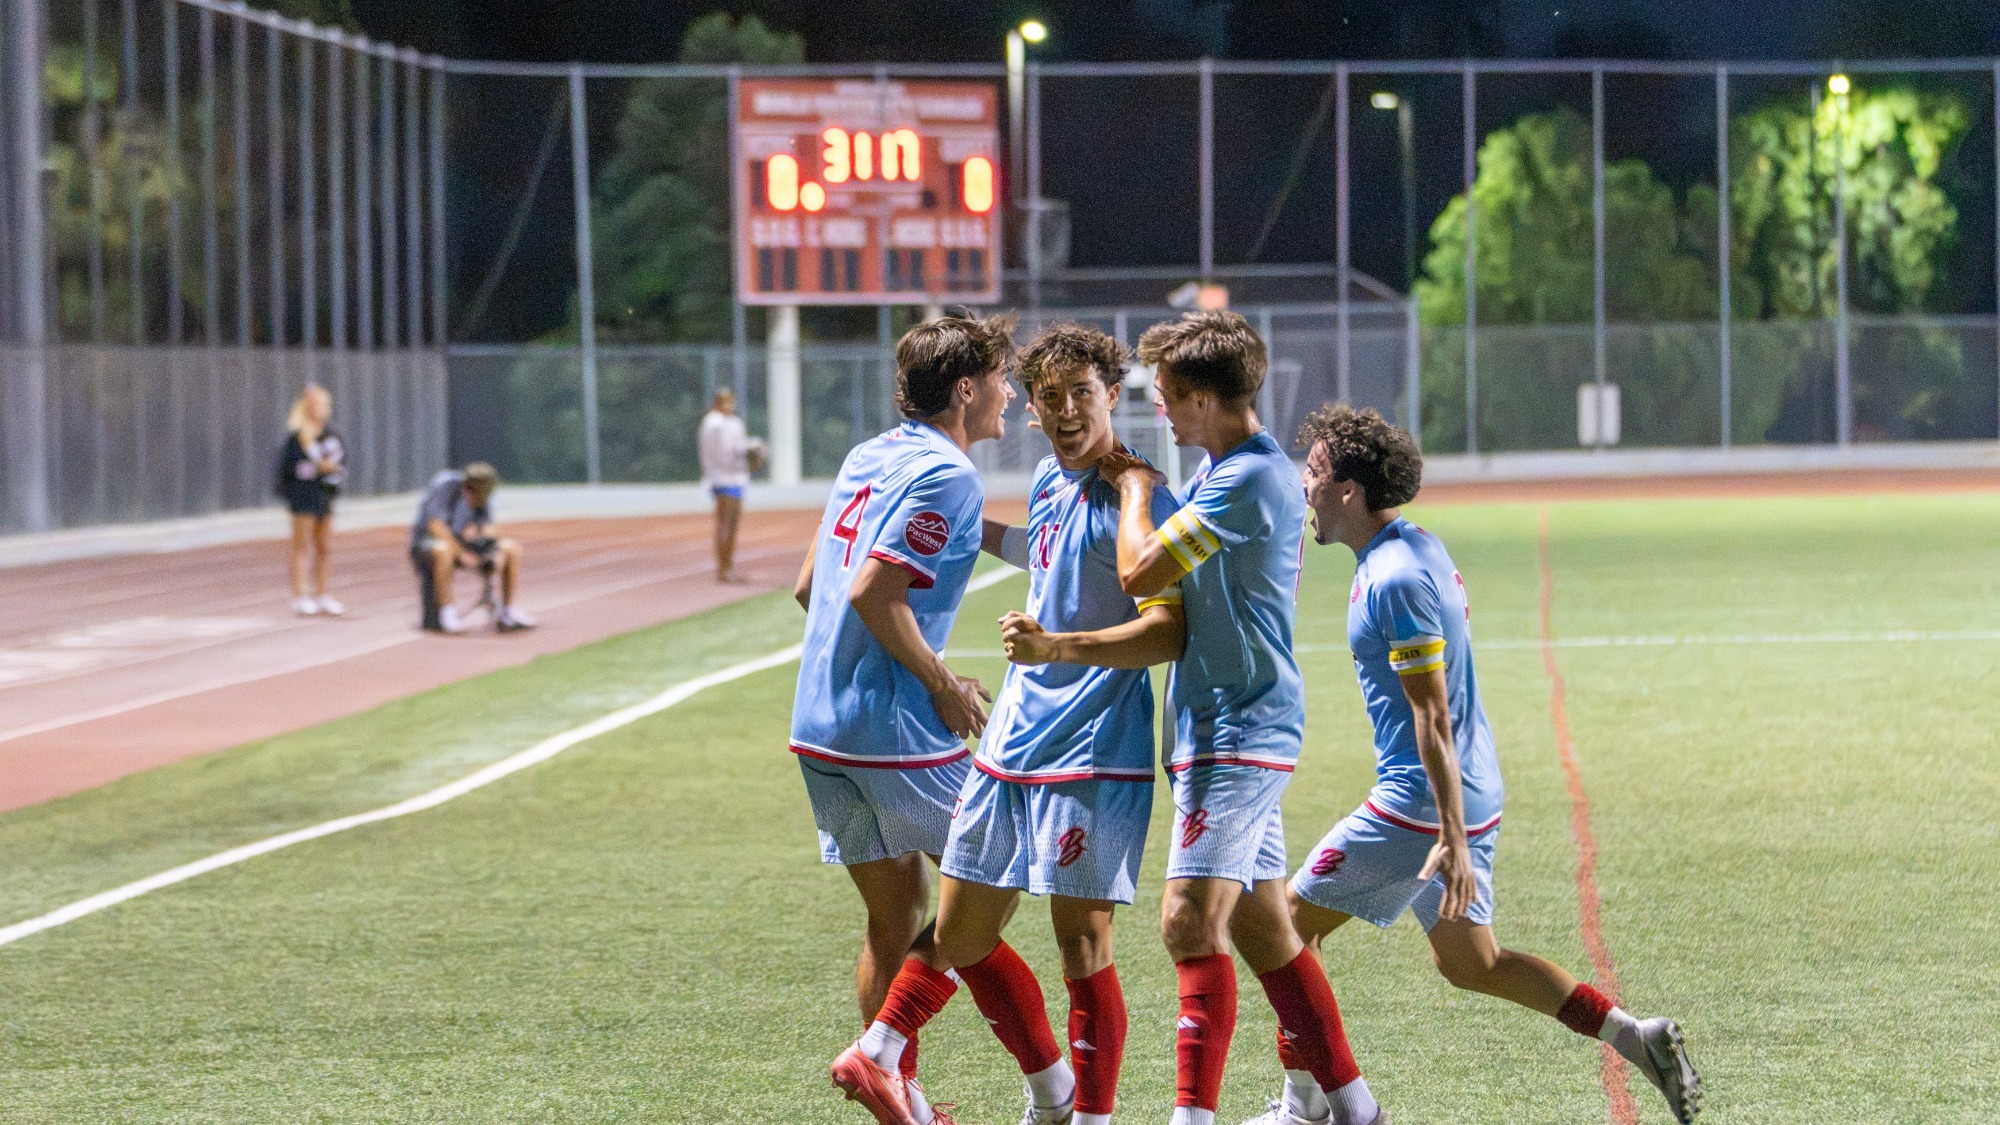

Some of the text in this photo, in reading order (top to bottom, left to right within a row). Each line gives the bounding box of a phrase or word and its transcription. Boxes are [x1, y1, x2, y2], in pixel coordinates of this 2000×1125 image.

[832, 482, 873, 572] 4
[907, 525, 942, 549] PacWest
[1058, 827, 1086, 867] B
[1182, 809, 1208, 848] B
[1312, 849, 1345, 875] B
